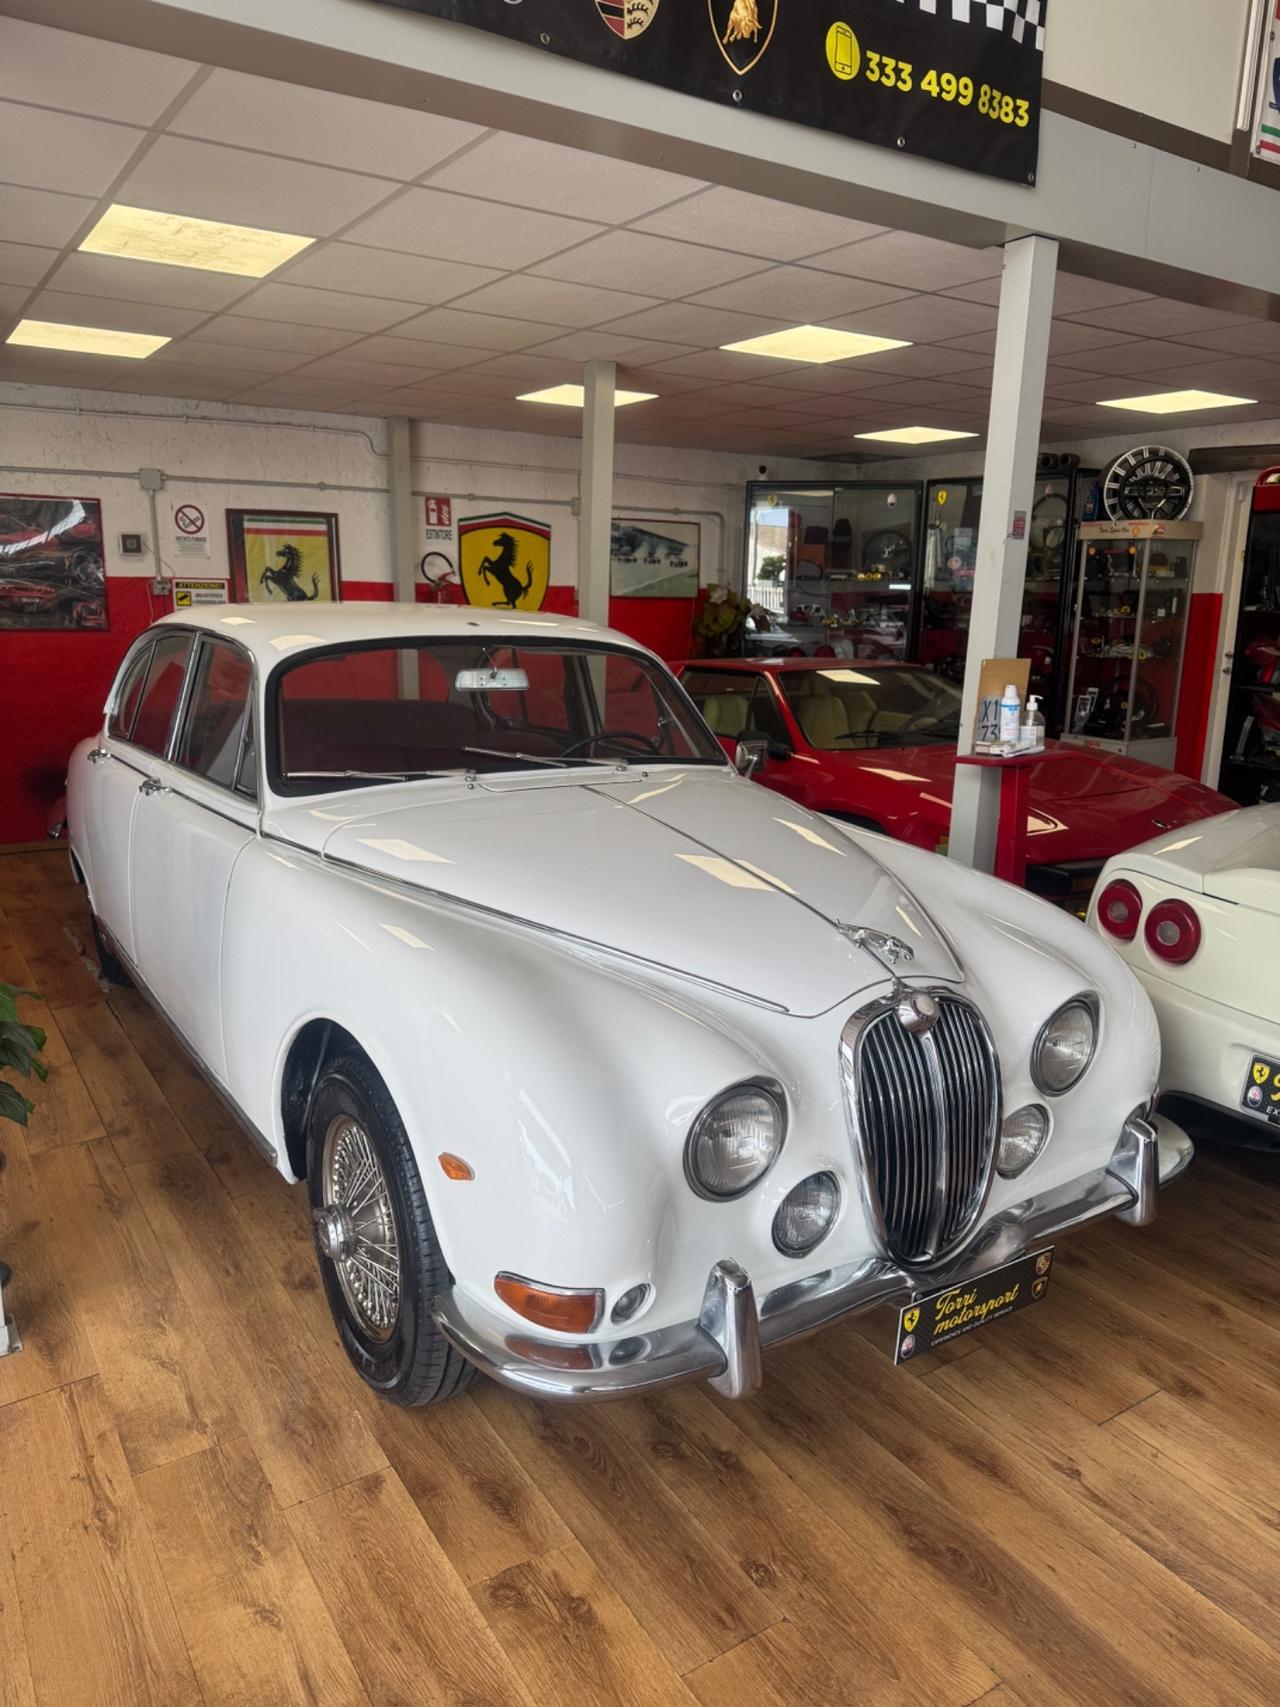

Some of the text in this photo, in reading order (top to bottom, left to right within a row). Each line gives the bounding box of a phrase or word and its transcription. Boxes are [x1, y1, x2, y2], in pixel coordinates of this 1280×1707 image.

[865, 49, 1030, 128] 333 499 8383
[932, 1283, 1020, 1336] motorsport
[935, 1288, 978, 1320] Torri
